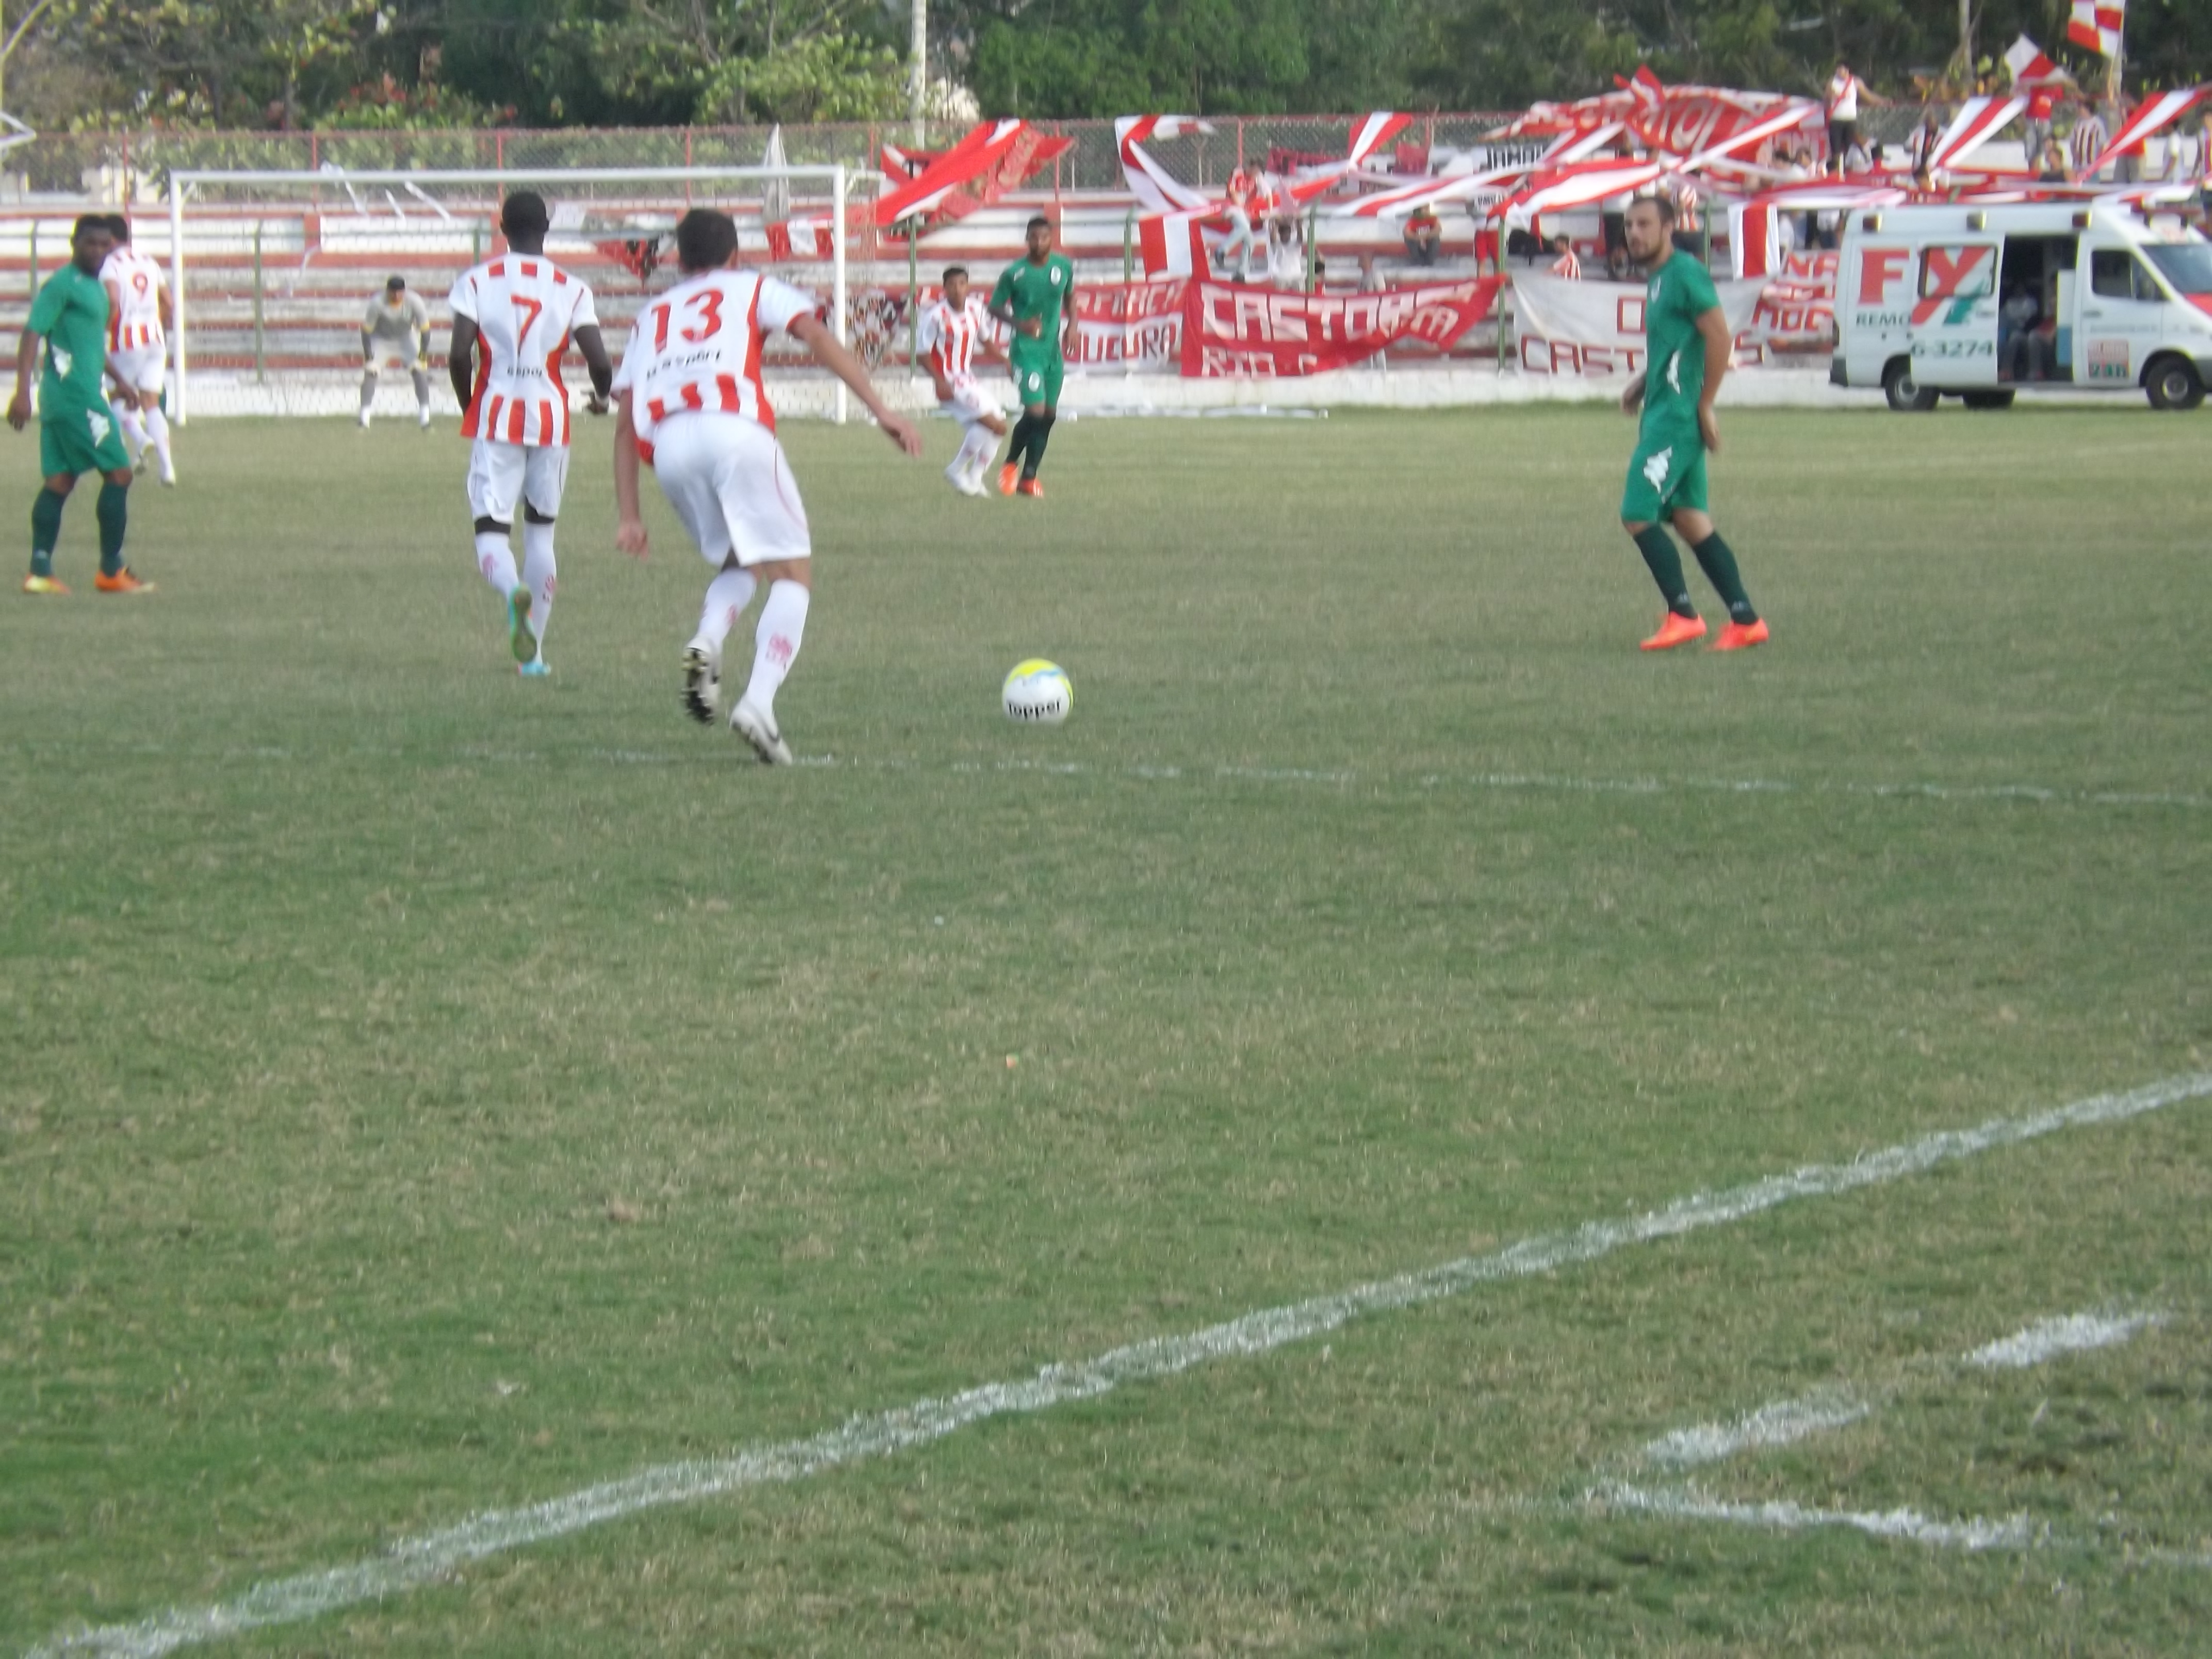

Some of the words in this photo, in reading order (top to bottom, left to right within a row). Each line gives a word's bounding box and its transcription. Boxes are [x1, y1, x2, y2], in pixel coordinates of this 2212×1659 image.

[132, 271, 148, 301] 9
[511, 294, 542, 354] 7
[651, 289, 724, 354] 13
